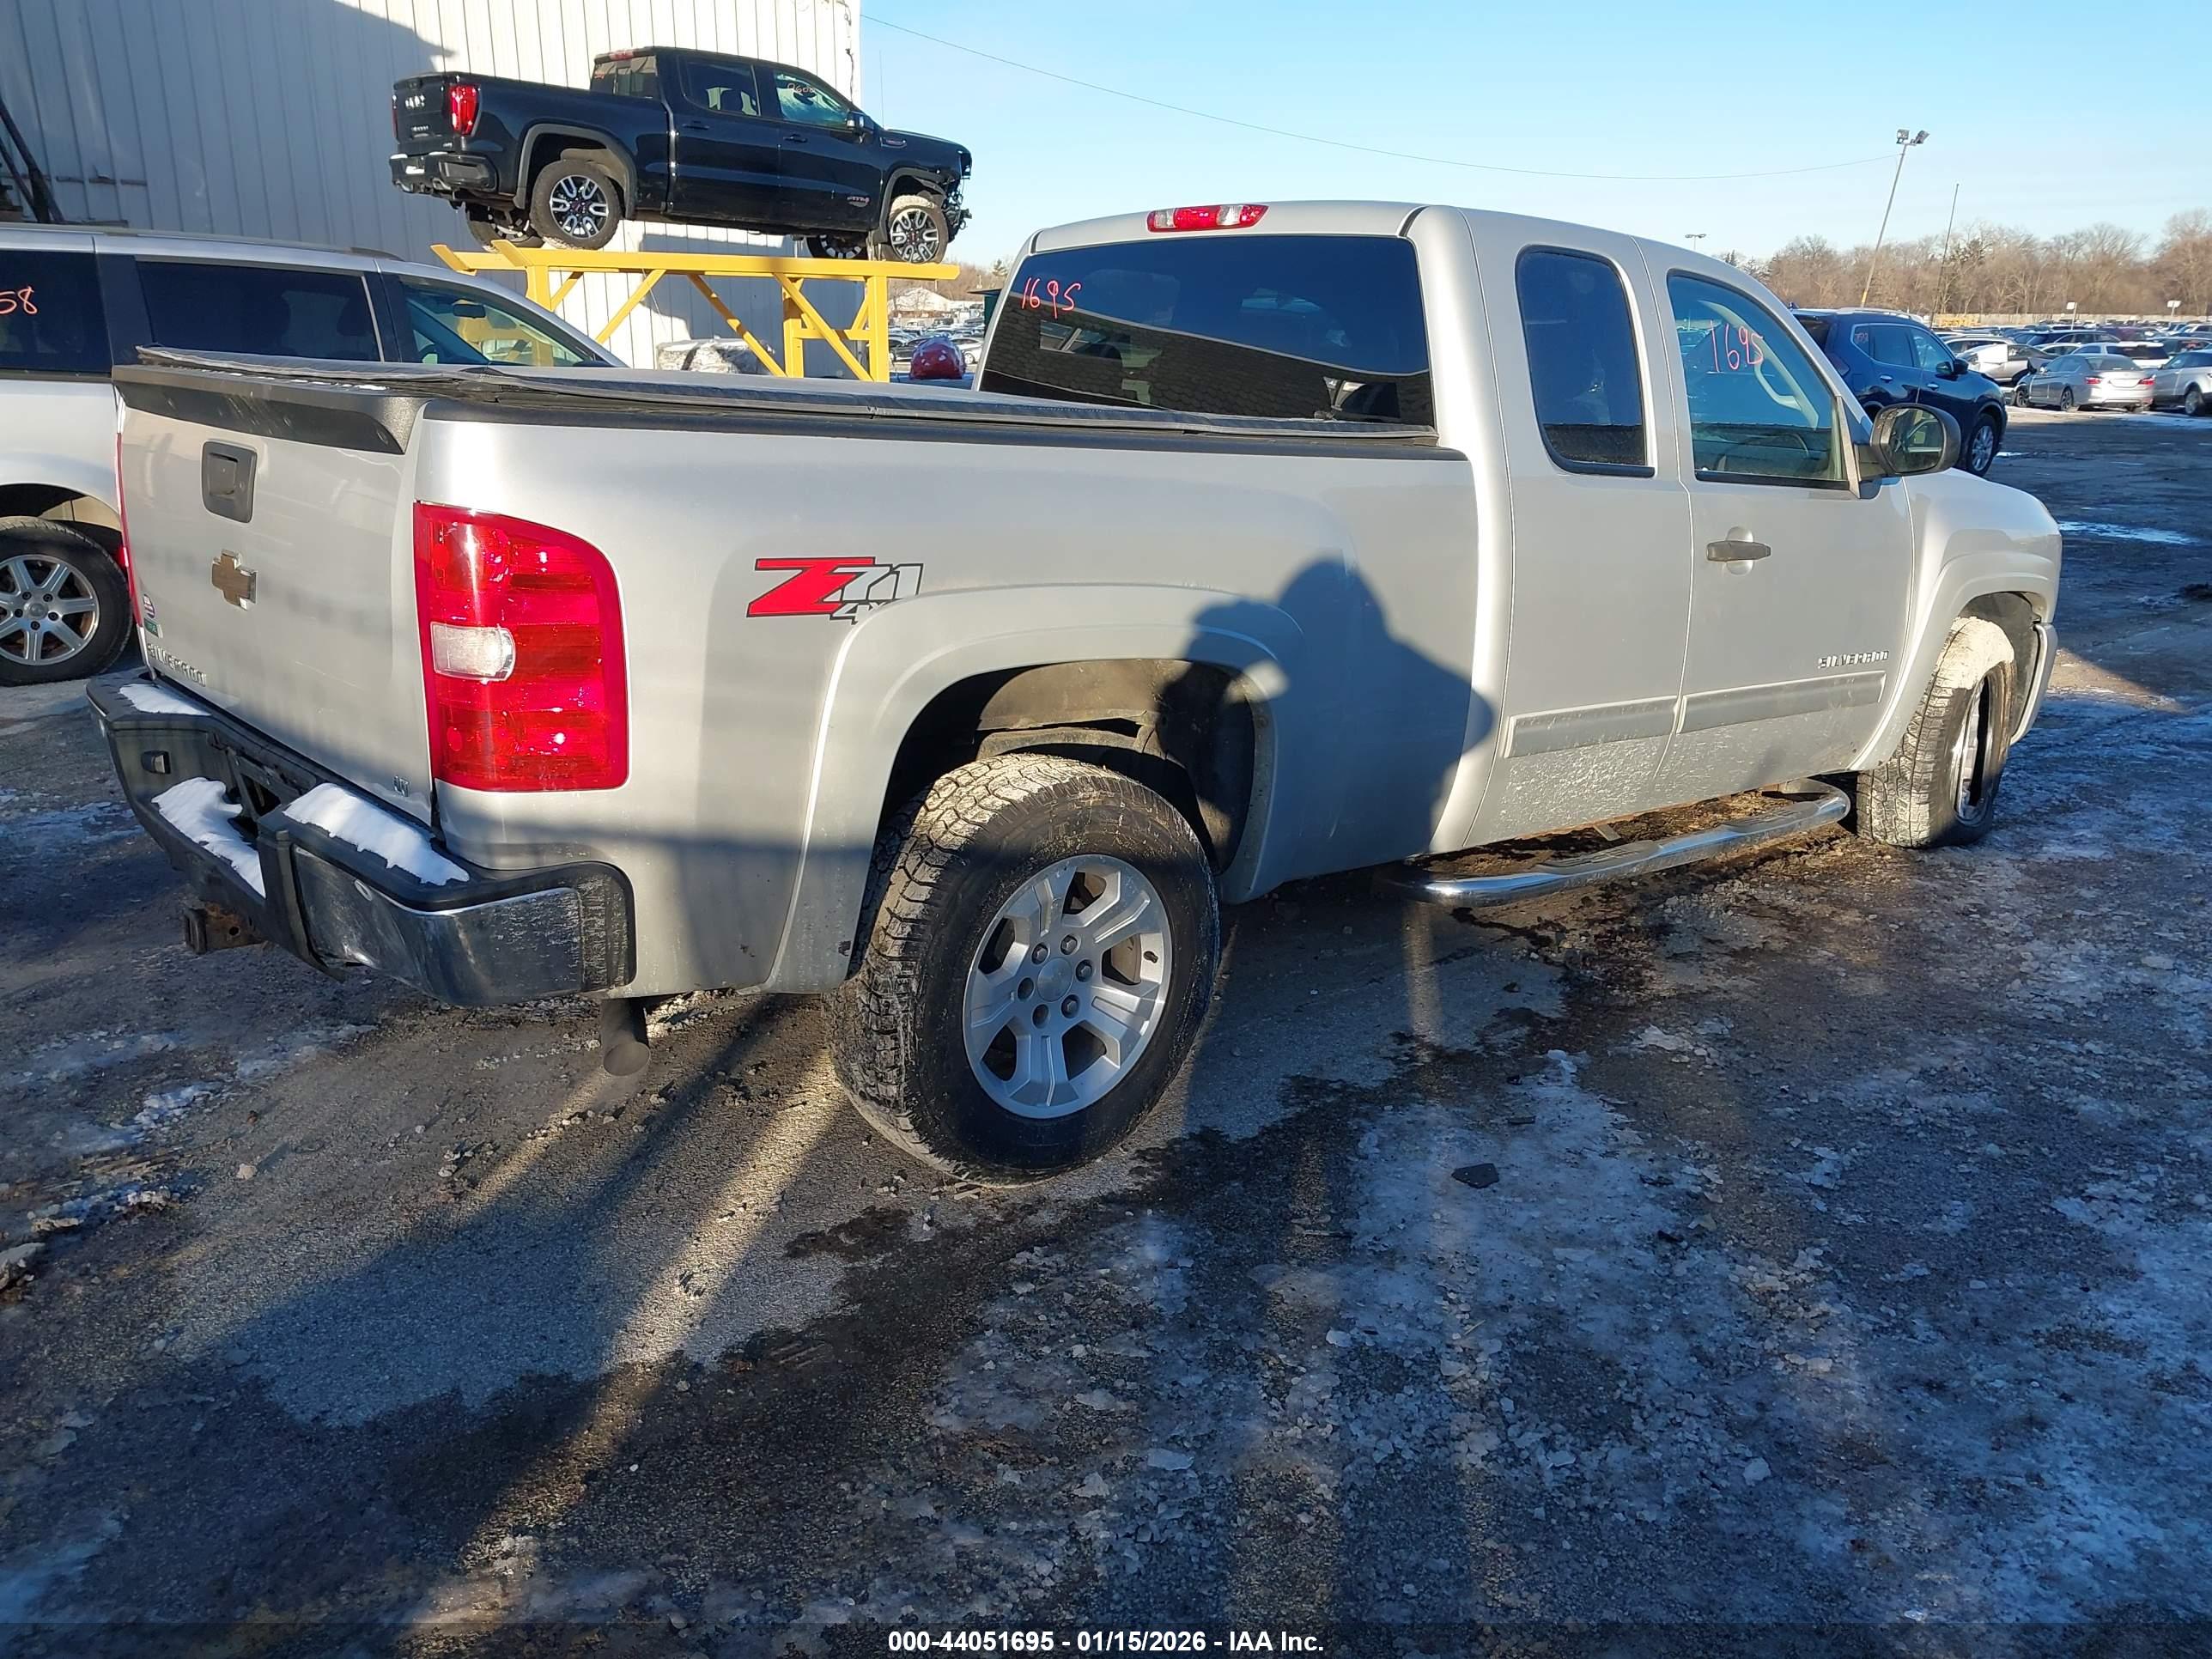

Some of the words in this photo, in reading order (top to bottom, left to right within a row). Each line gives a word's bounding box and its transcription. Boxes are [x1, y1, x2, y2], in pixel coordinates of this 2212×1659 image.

[1021, 276, 1082, 319] 1695
[1710, 319, 1765, 373] 1695
[745, 556, 925, 618] Z71
[1817, 650, 1890, 670] SILVERADO
